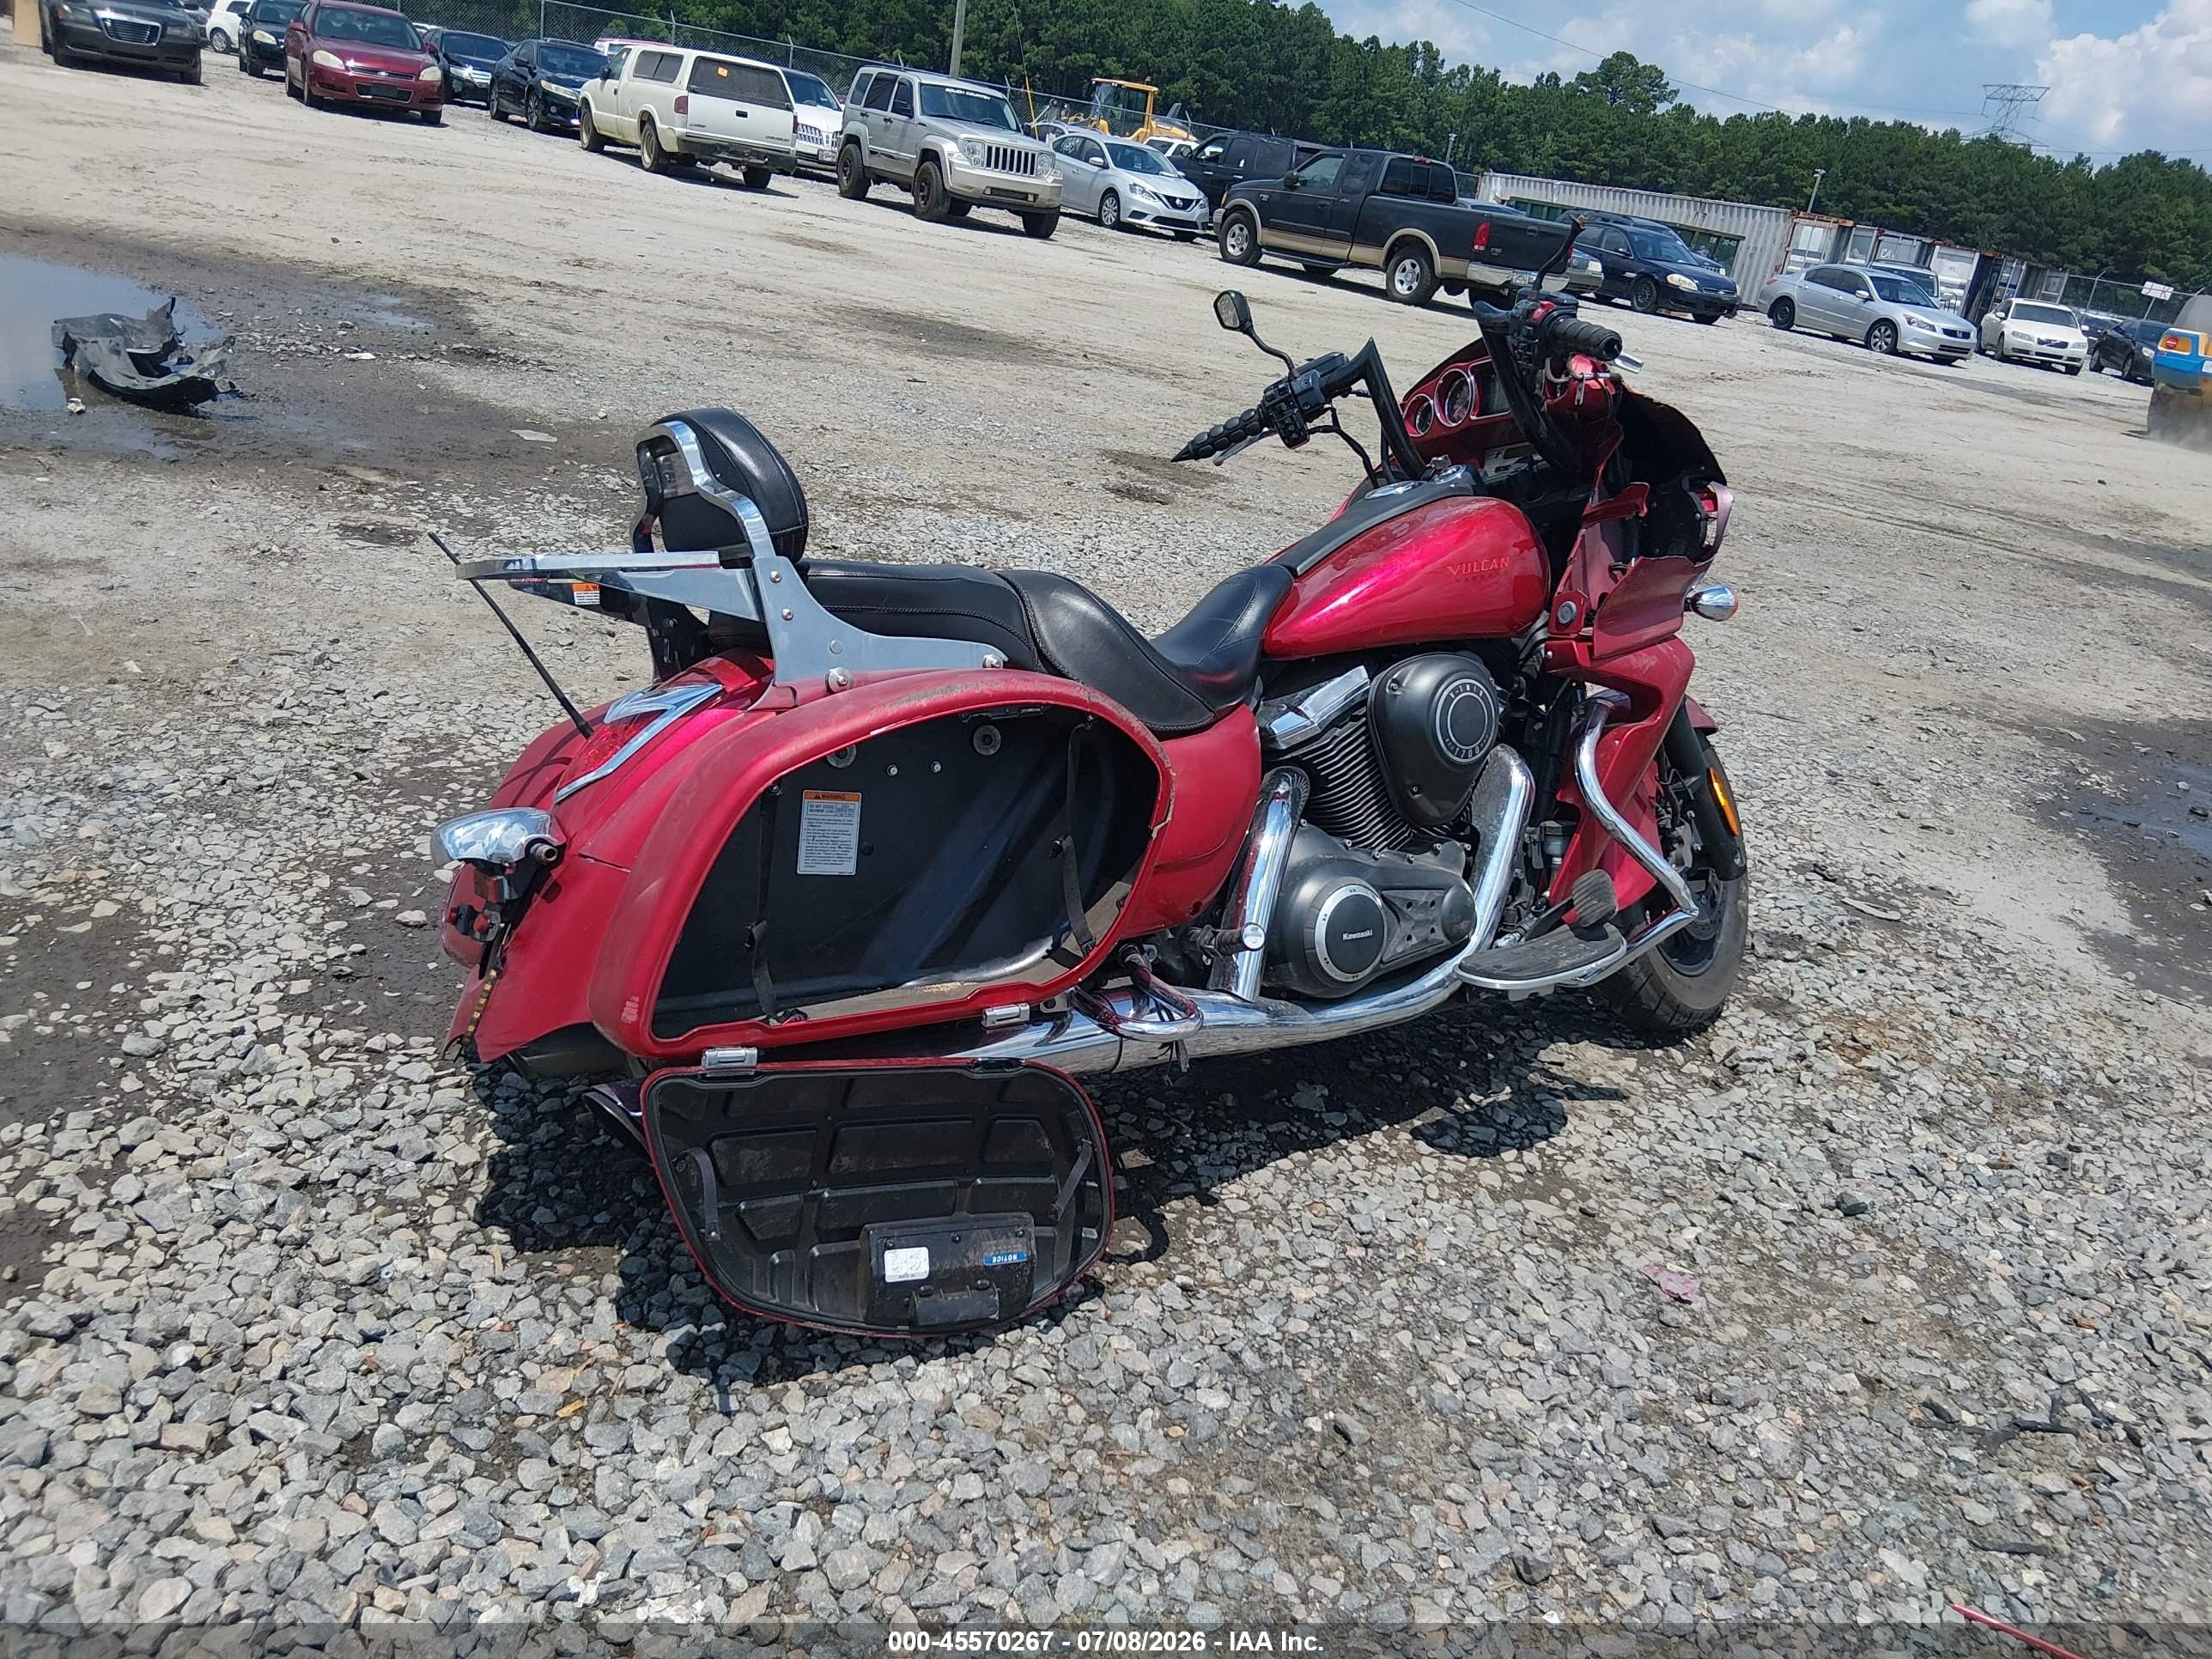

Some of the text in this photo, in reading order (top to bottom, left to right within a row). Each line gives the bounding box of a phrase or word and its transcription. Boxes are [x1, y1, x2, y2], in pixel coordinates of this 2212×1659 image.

[1446, 556, 1510, 576] VULCAN
[1449, 684, 1484, 699] V-TWIN
[1454, 745, 1480, 758] 1700
[1342, 928, 1373, 941] Kawasaki
[992, 1254, 1018, 1263] NOTICE
